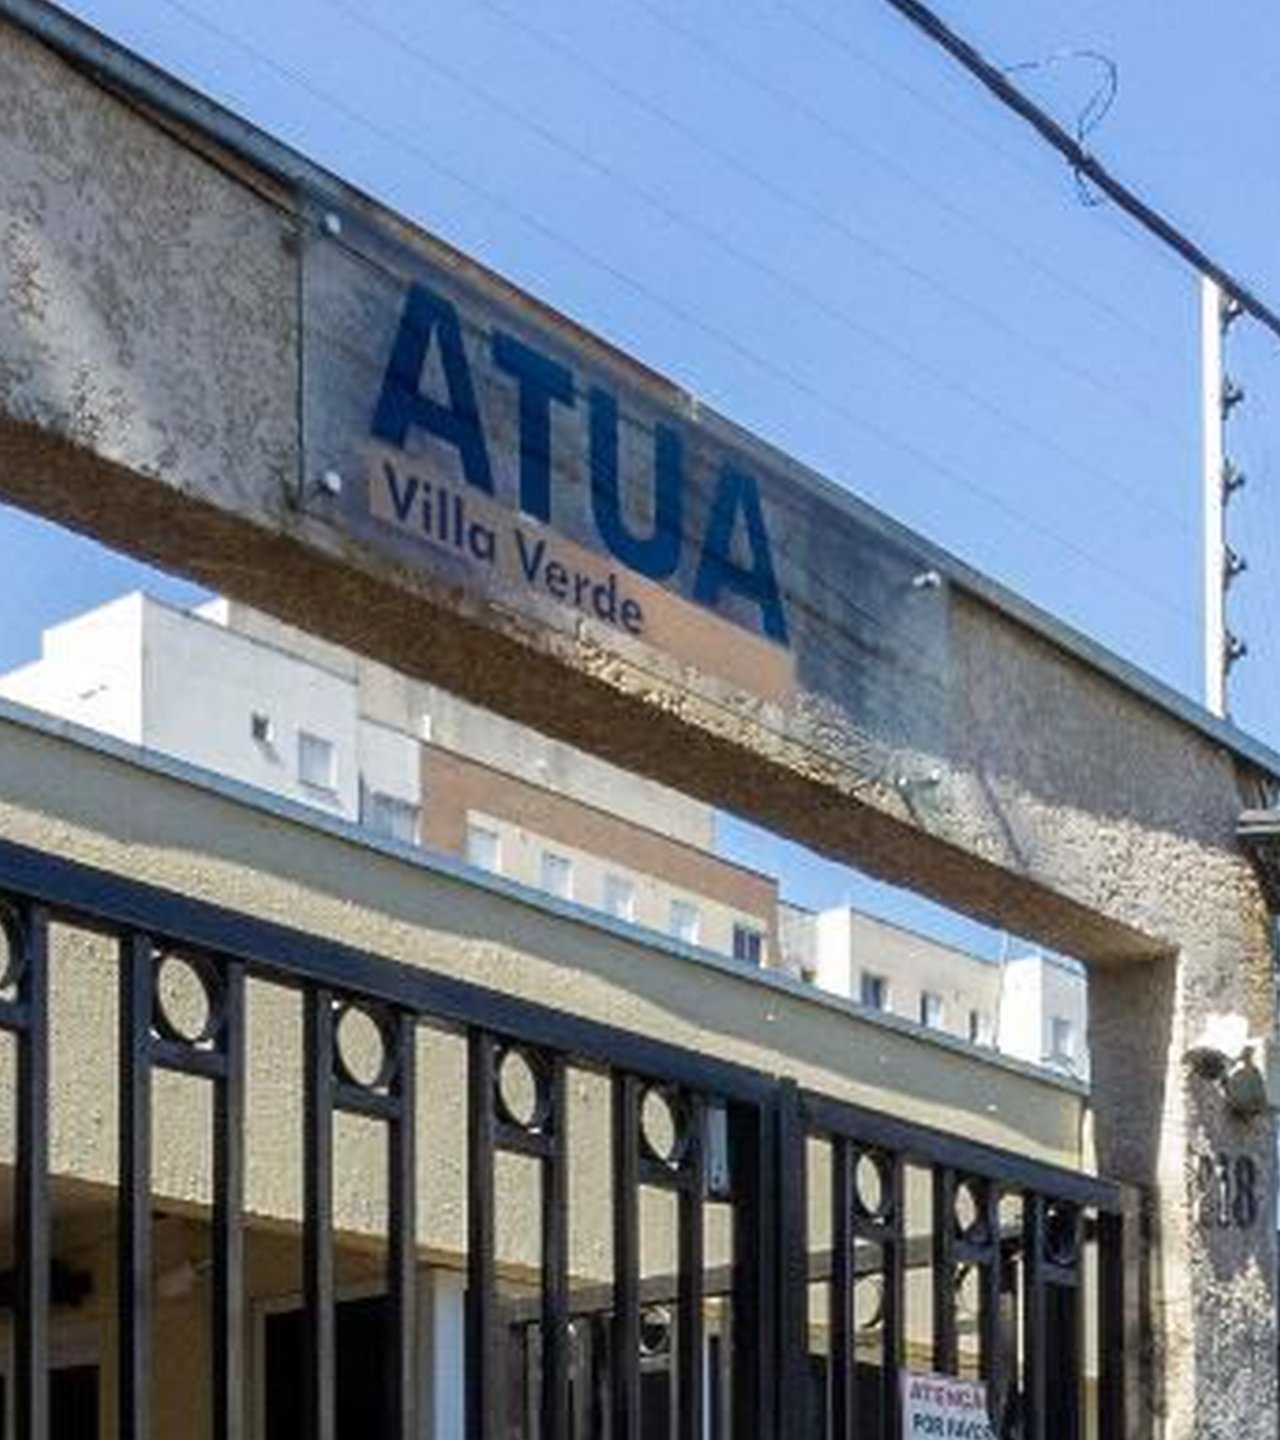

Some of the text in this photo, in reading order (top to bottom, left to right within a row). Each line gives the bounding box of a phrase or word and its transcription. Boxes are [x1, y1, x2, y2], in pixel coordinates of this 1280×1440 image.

[369, 282, 791, 649] ATUA
[381, 462, 644, 636] Villa Verde
[913, 1413, 945, 1438] POR
